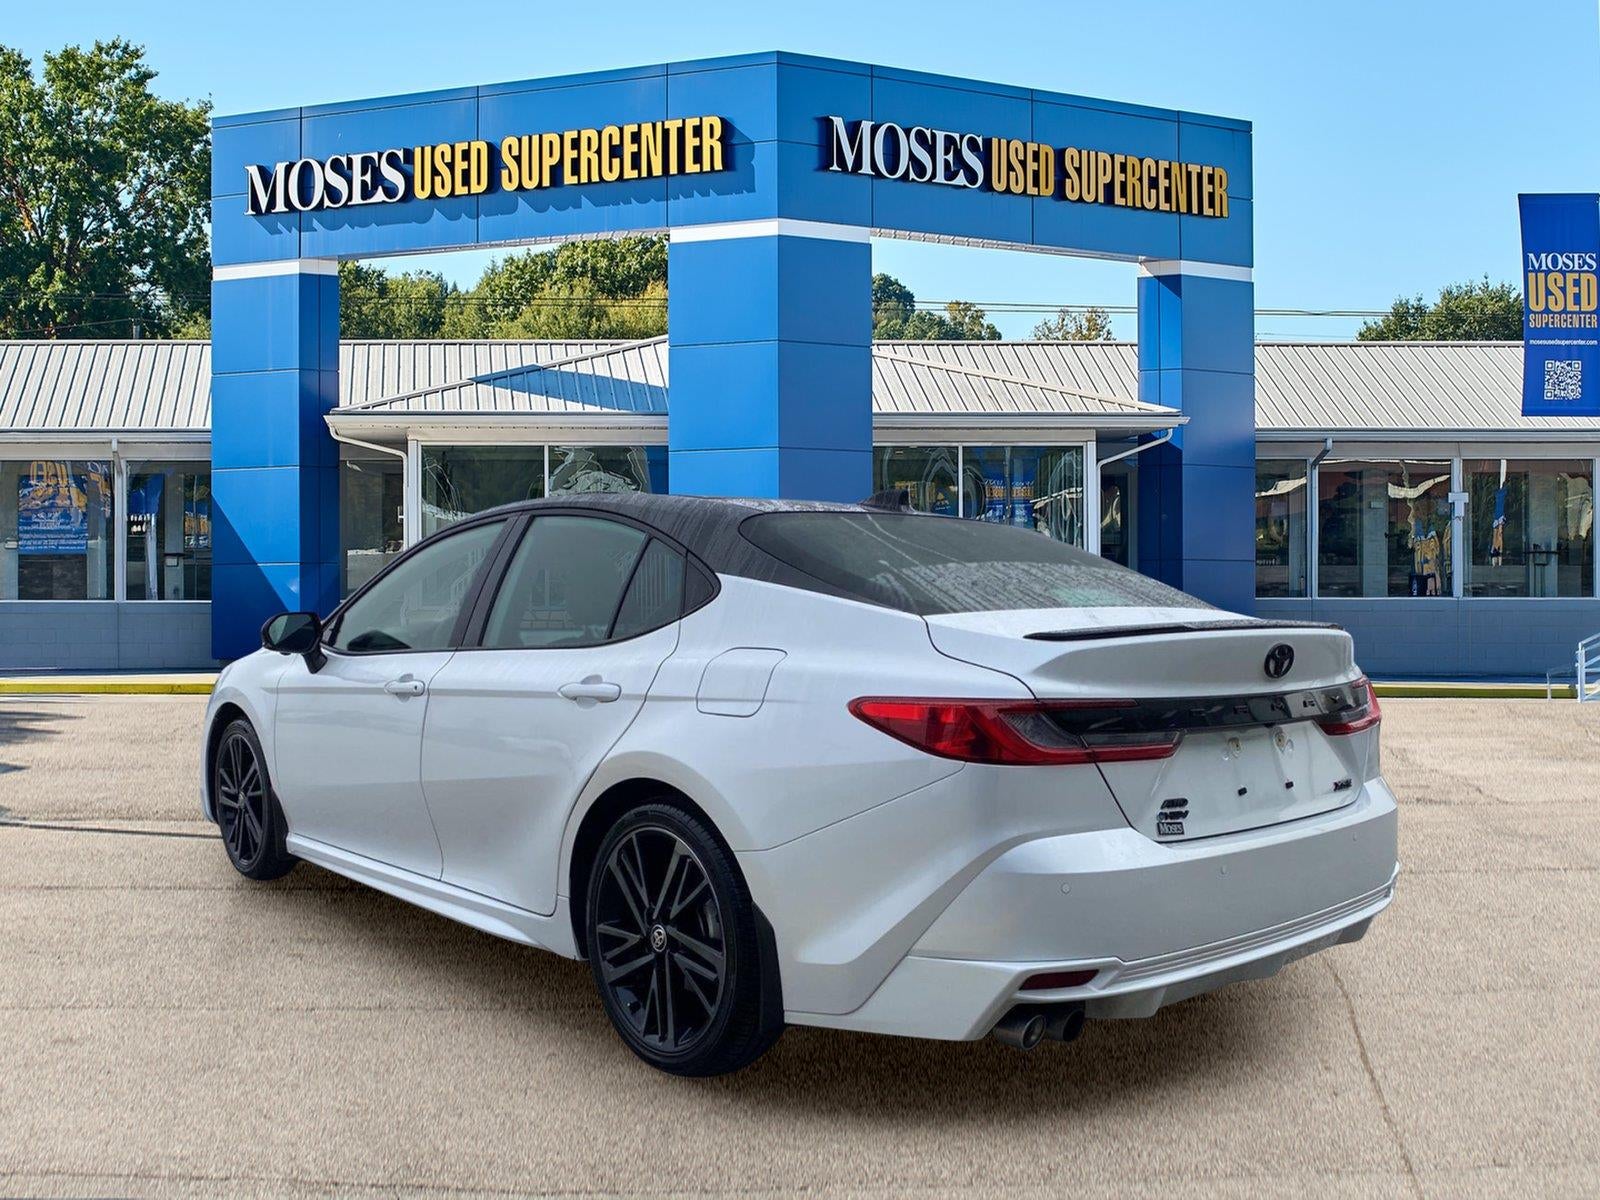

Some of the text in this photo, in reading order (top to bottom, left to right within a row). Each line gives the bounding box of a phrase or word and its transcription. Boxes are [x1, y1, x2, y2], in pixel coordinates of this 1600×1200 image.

[244, 115, 724, 216] MOSES USED SUPERCENTER
[828, 115, 1229, 218] MOSES USED SUPERCENTER
[1527, 252, 1596, 271] MOSES
[1528, 272, 1598, 312] USED
[1529, 313, 1598, 329] SUPERCENTER
